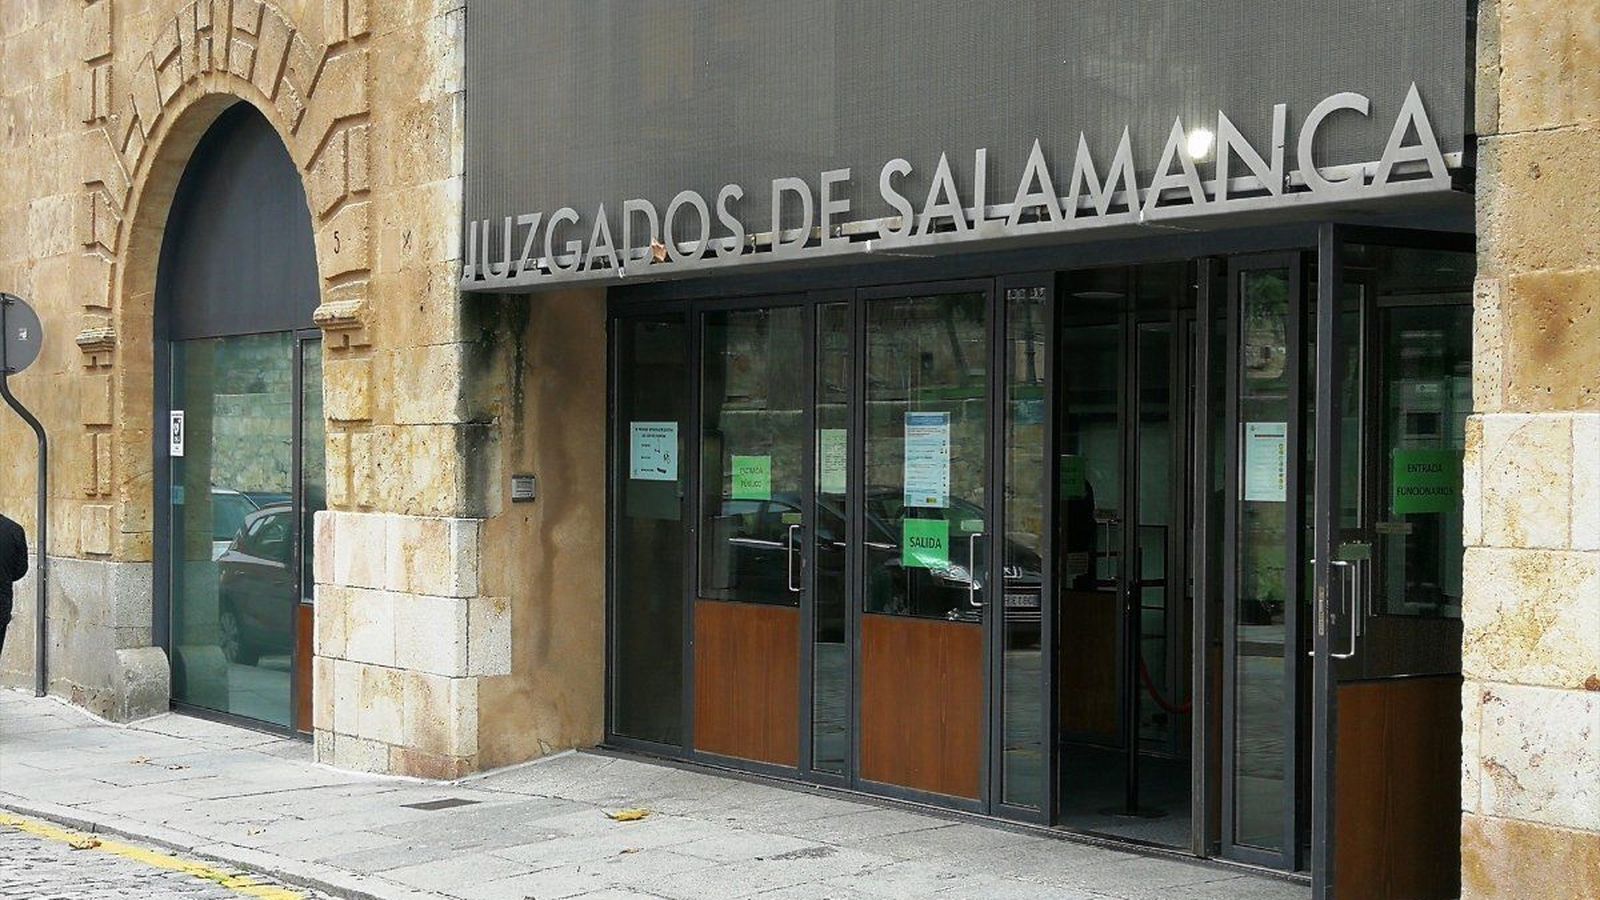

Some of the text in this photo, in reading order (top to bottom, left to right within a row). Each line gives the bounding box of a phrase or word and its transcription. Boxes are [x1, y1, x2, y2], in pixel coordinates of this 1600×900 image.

[461, 81, 1449, 280] JUZGADOS DE SALAMANCA
[334, 231, 341, 253] 5
[1407, 463, 1442, 473] ENTRADA
[909, 536, 942, 550] SALIDA
